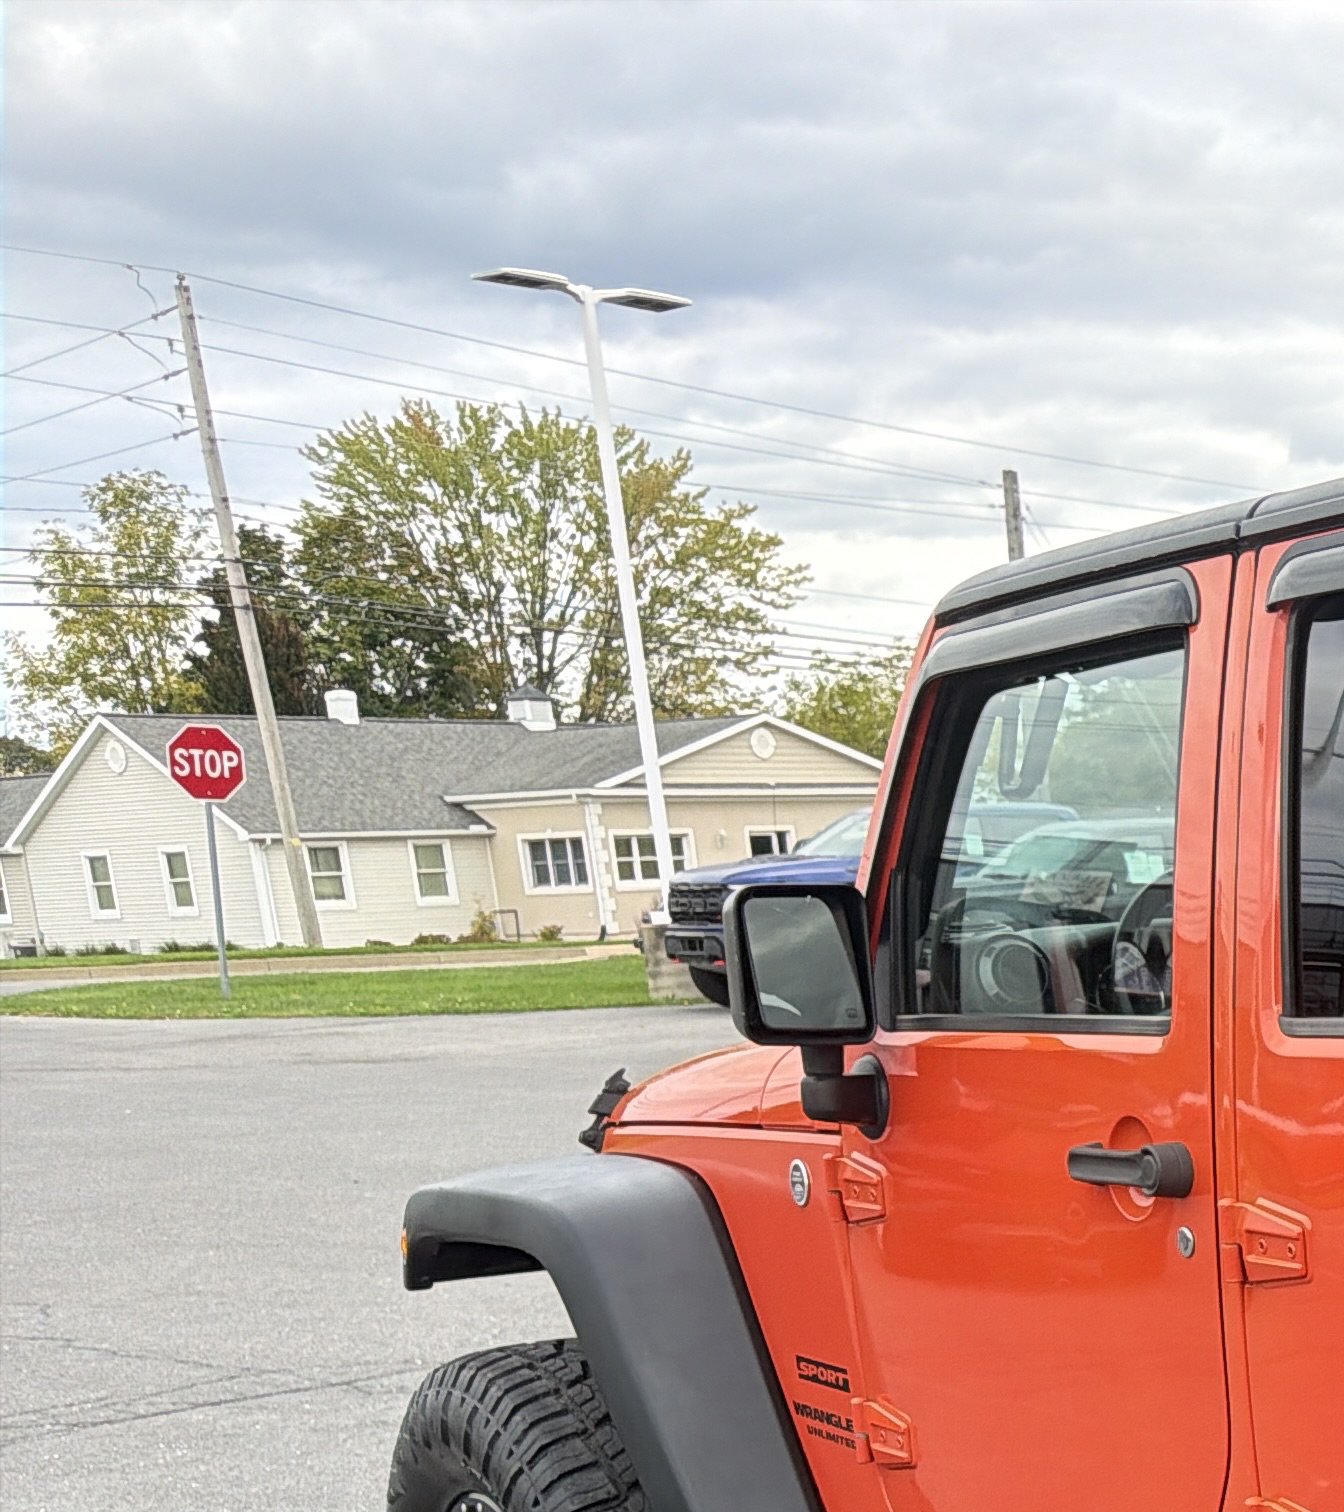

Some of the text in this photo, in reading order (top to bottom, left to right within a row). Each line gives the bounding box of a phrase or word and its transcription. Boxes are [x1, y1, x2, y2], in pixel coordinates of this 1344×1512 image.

[173, 747, 239, 779] STOP
[799, 1361, 845, 1388] SPORT
[792, 1400, 855, 1433] WRANGLE
